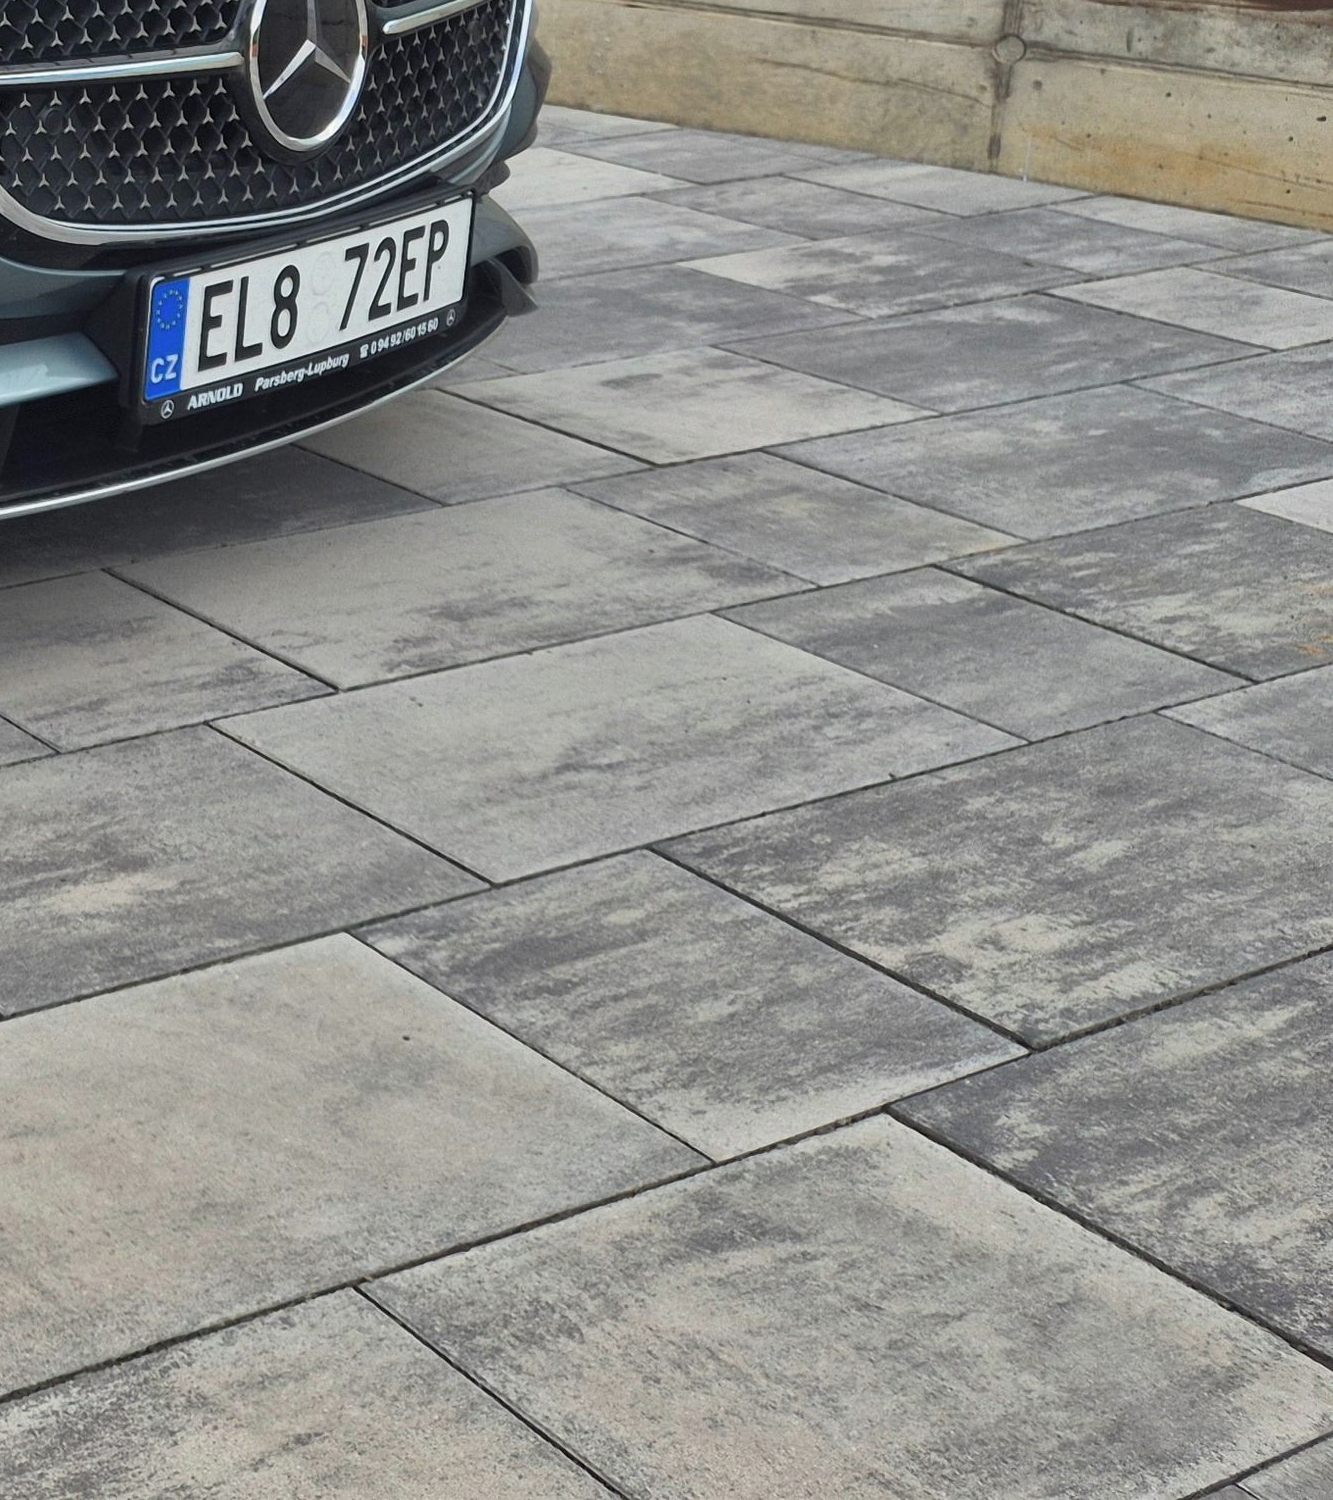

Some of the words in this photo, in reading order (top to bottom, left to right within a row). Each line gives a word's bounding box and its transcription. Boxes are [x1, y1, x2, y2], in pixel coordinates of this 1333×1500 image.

[197, 264, 301, 372] EL8
[339, 219, 450, 332] 72EP
[150, 353, 179, 383] CZ
[187, 383, 244, 411] ARNOLD
[254, 353, 350, 393] Parsberg-Lupburg
